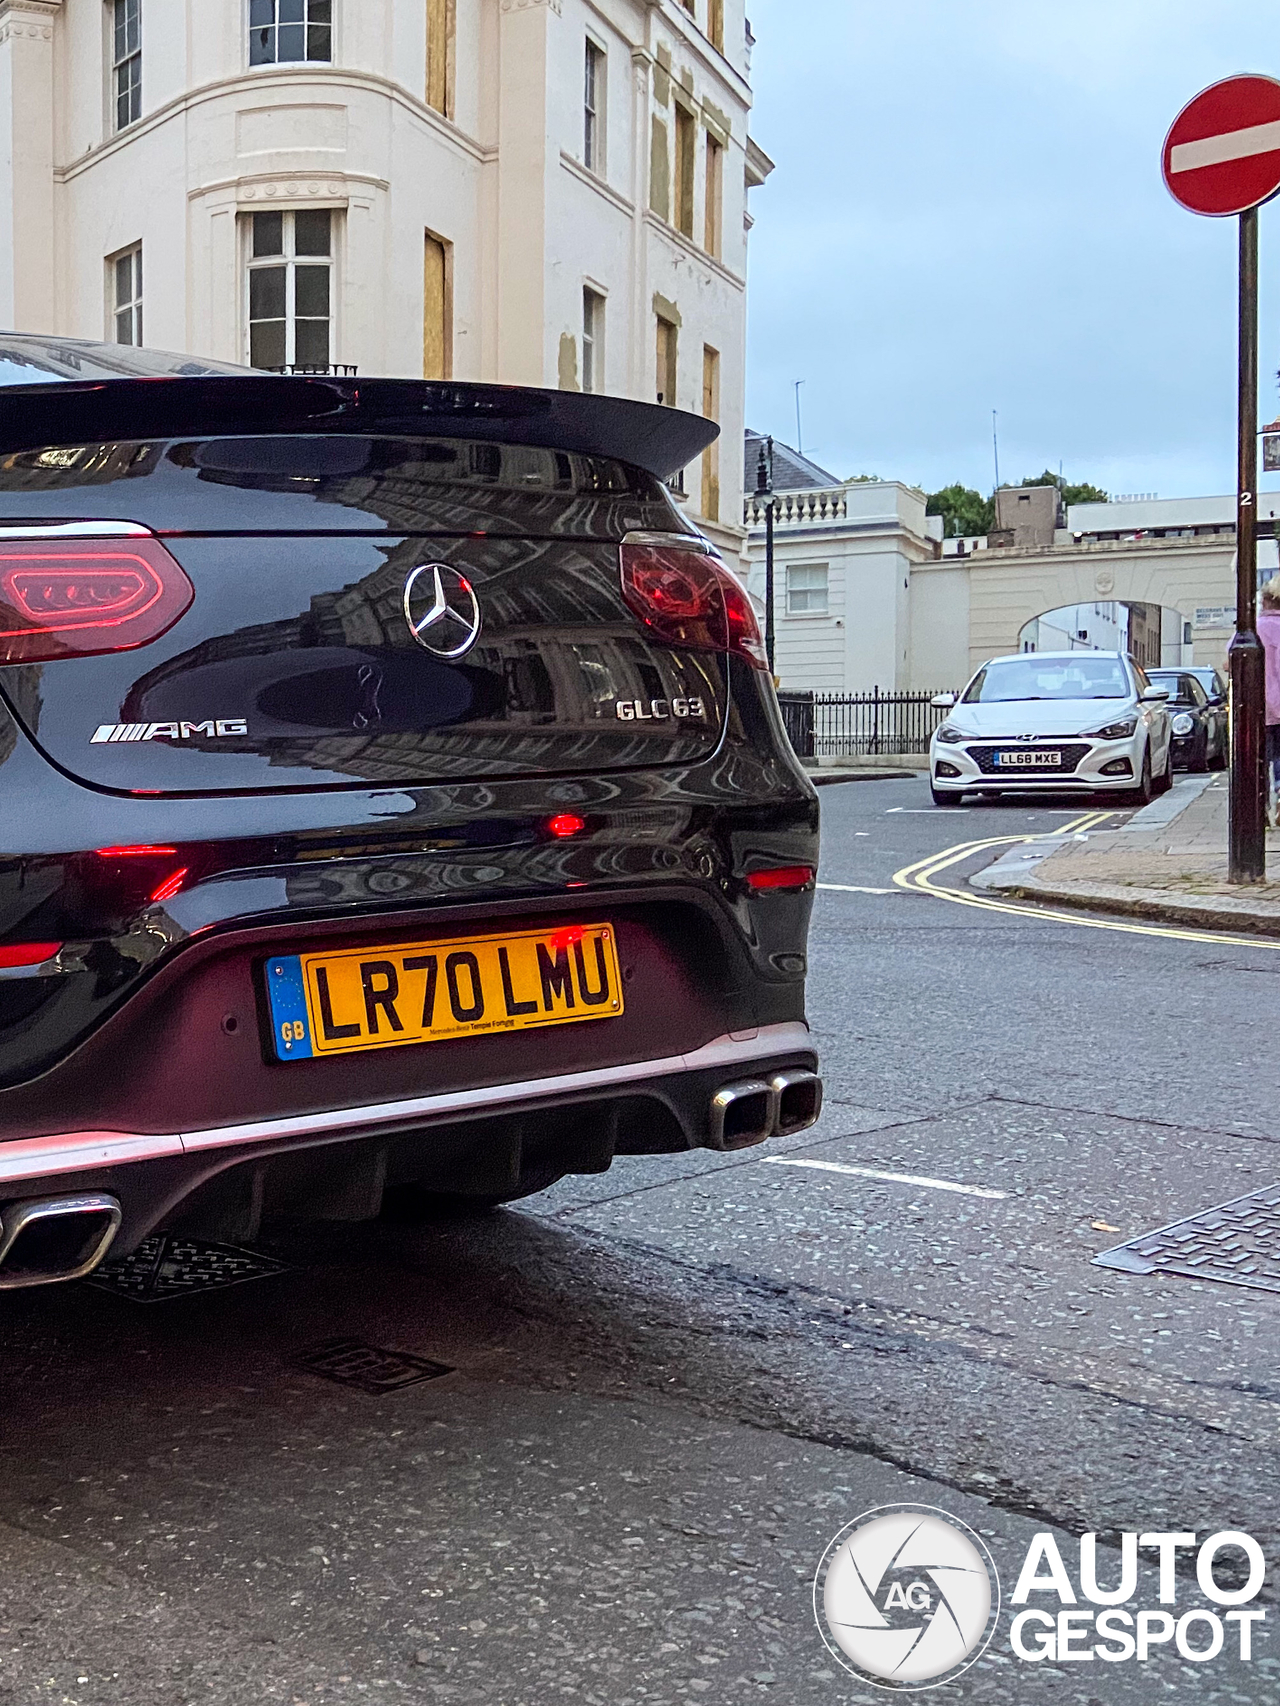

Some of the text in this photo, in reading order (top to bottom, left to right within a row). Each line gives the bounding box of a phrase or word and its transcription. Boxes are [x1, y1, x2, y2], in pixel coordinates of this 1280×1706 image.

[1240, 491, 1252, 506] 2
[616, 697, 704, 720] GLC 63
[142, 719, 247, 740] AMG
[1001, 753, 1059, 764] LL68 MXE
[316, 937, 610, 1040] LR70 LMU
[281, 1020, 305, 1041] GB
